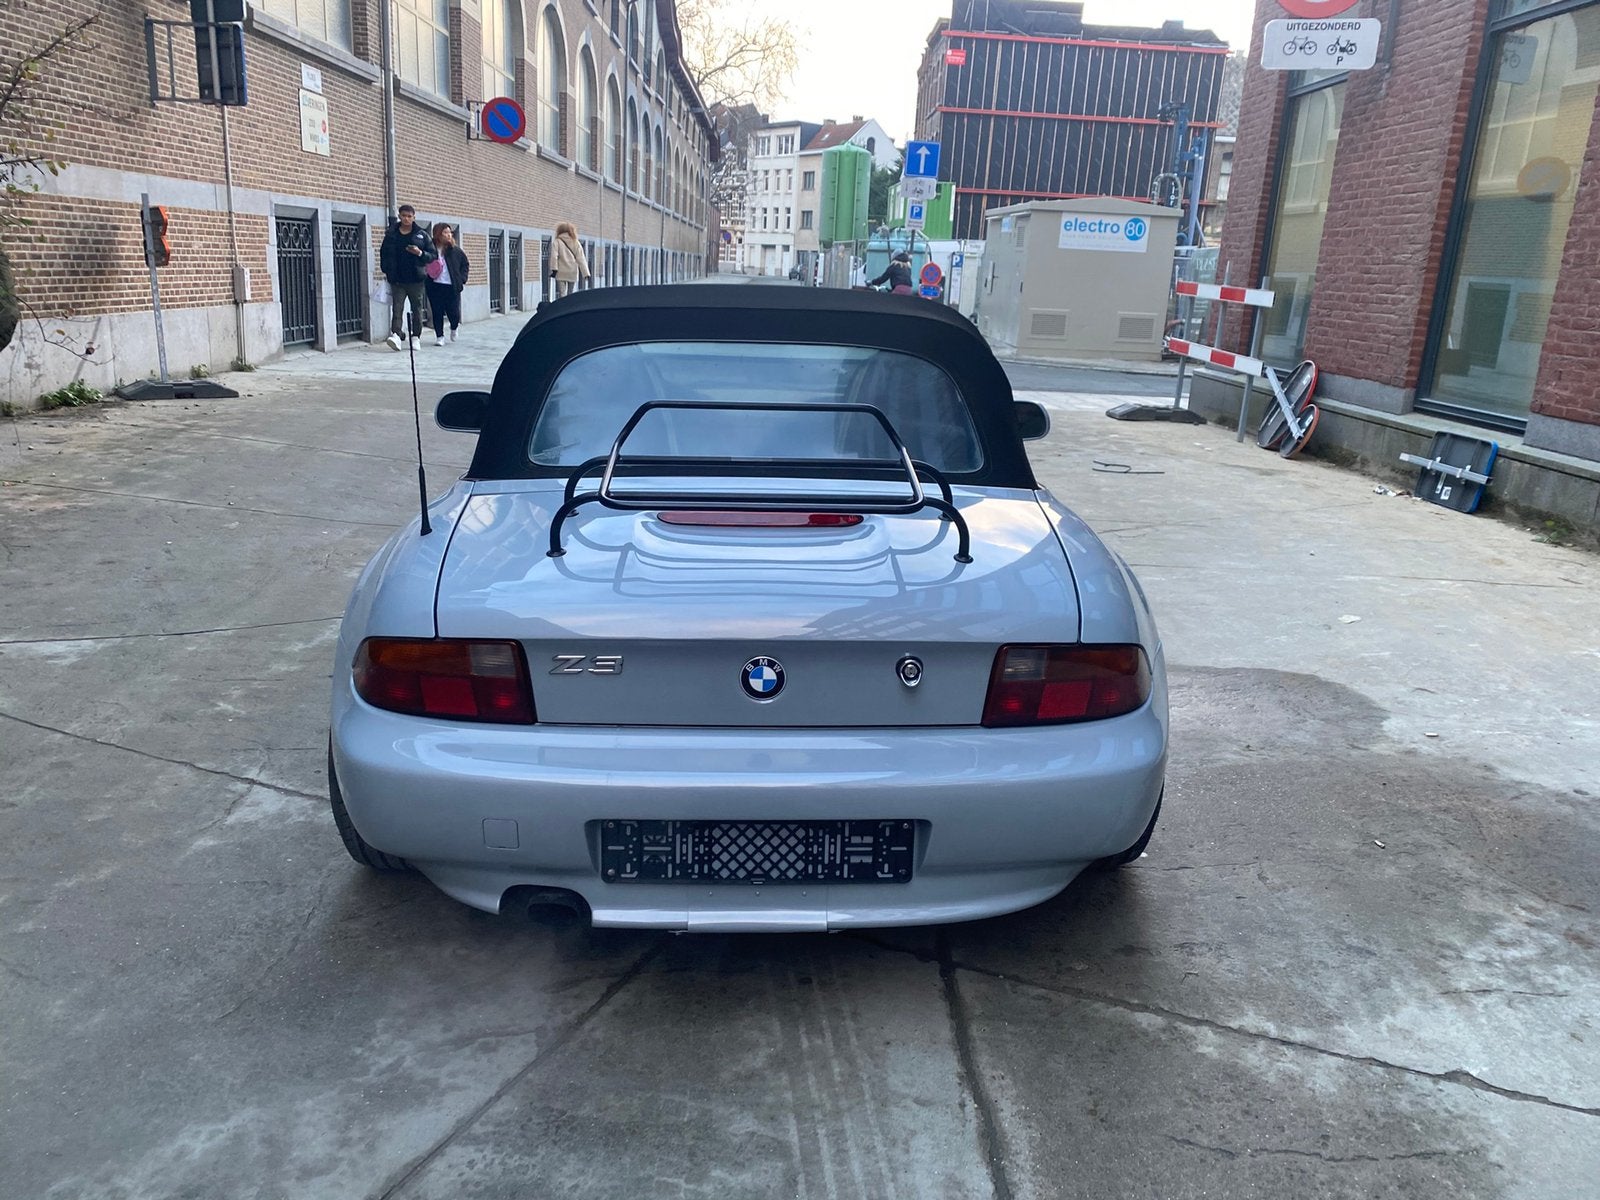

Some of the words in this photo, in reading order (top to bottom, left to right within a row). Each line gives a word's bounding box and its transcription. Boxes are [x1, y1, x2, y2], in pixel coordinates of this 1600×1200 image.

[1286, 22, 1361, 31] UITGEZONDERD
[1336, 56, 1344, 65] P
[1063, 217, 1120, 234] electro
[1125, 220, 1145, 237] 80
[549, 654, 624, 675] Z3
[745, 658, 782, 672] BMW
